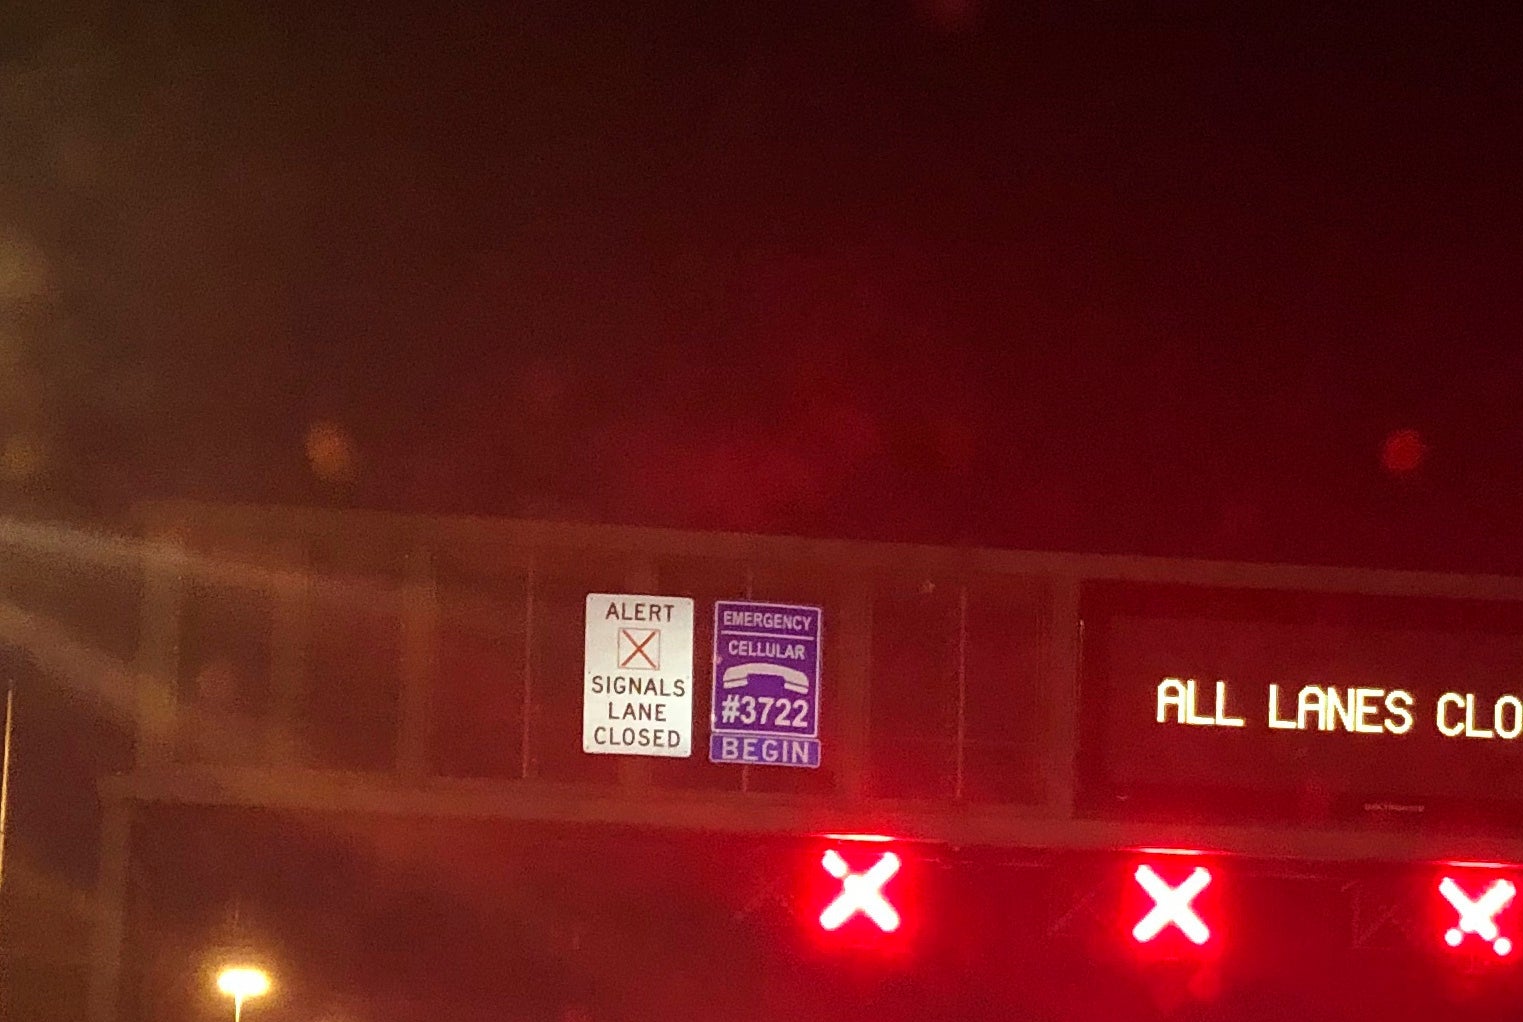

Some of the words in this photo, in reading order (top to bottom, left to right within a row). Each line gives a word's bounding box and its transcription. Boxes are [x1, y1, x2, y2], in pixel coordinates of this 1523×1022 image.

[605, 602, 675, 623] ALERT
[723, 610, 813, 632] EMERGENCY
[728, 639, 806, 661] CELLULAR
[591, 675, 686, 698] SIGNALS
[608, 701, 668, 722] LANE
[721, 693, 809, 728] #3722
[1156, 677, 1246, 728] ALL
[1267, 683, 1414, 735] LANES
[593, 726, 682, 749] CLOSED
[721, 738, 810, 764] BEGIN
